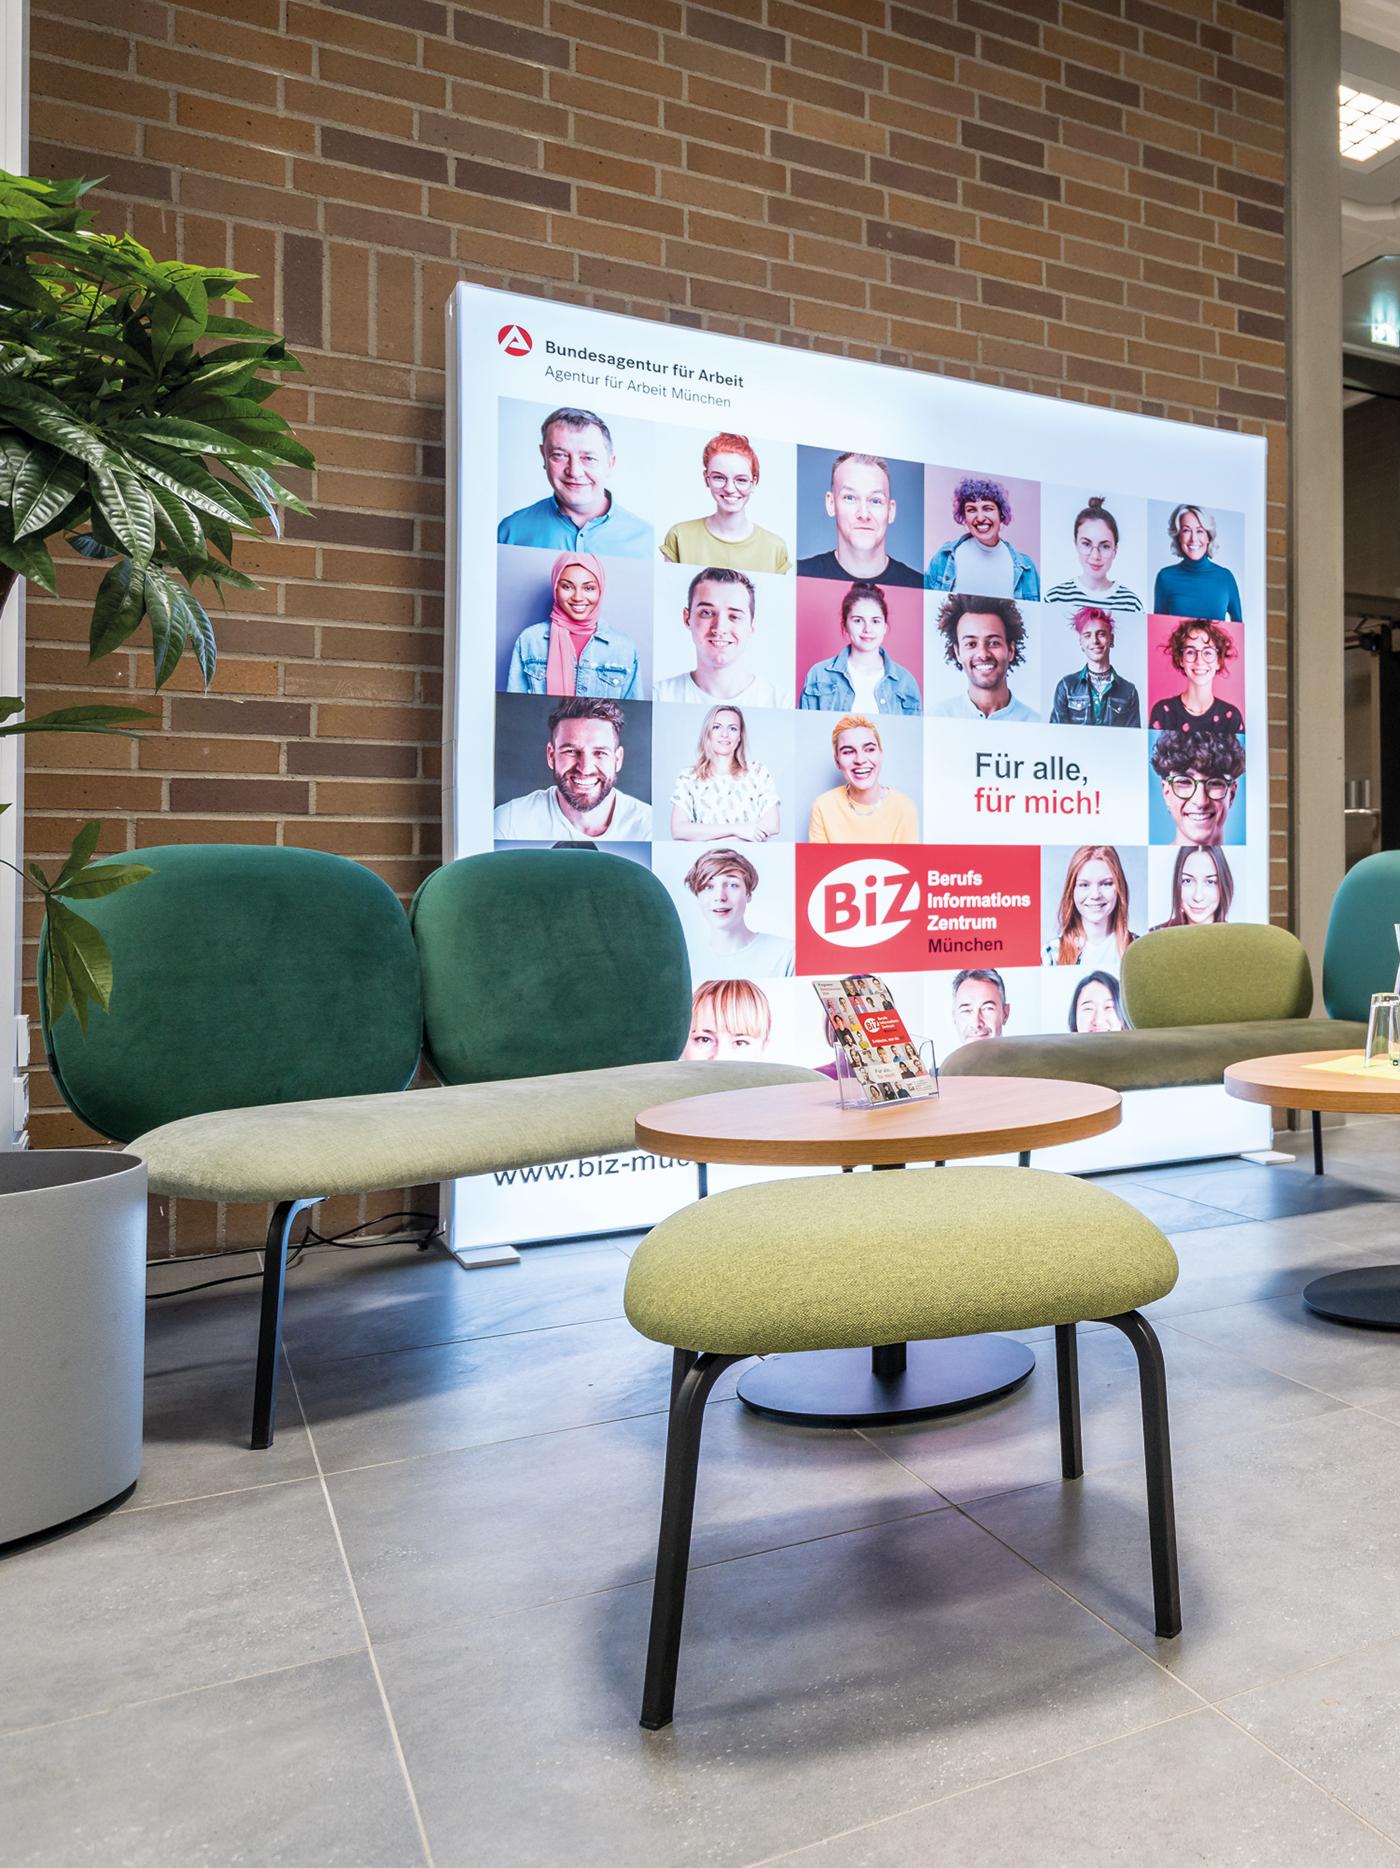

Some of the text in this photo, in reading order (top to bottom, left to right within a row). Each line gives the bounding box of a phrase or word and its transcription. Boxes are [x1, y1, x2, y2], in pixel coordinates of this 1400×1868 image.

[545, 340, 744, 388] Bundesagentur für Arbeit
[545, 365, 731, 408] Agentur für Arbeit München
[975, 752, 1089, 785] Für alle,
[974, 787, 1101, 815] für mich!
[927, 870, 983, 887] Berufs
[822, 870, 917, 935] BiZ
[927, 893, 1031, 909] Informations
[927, 915, 997, 931] Zentrum
[928, 937, 1003, 954] München
